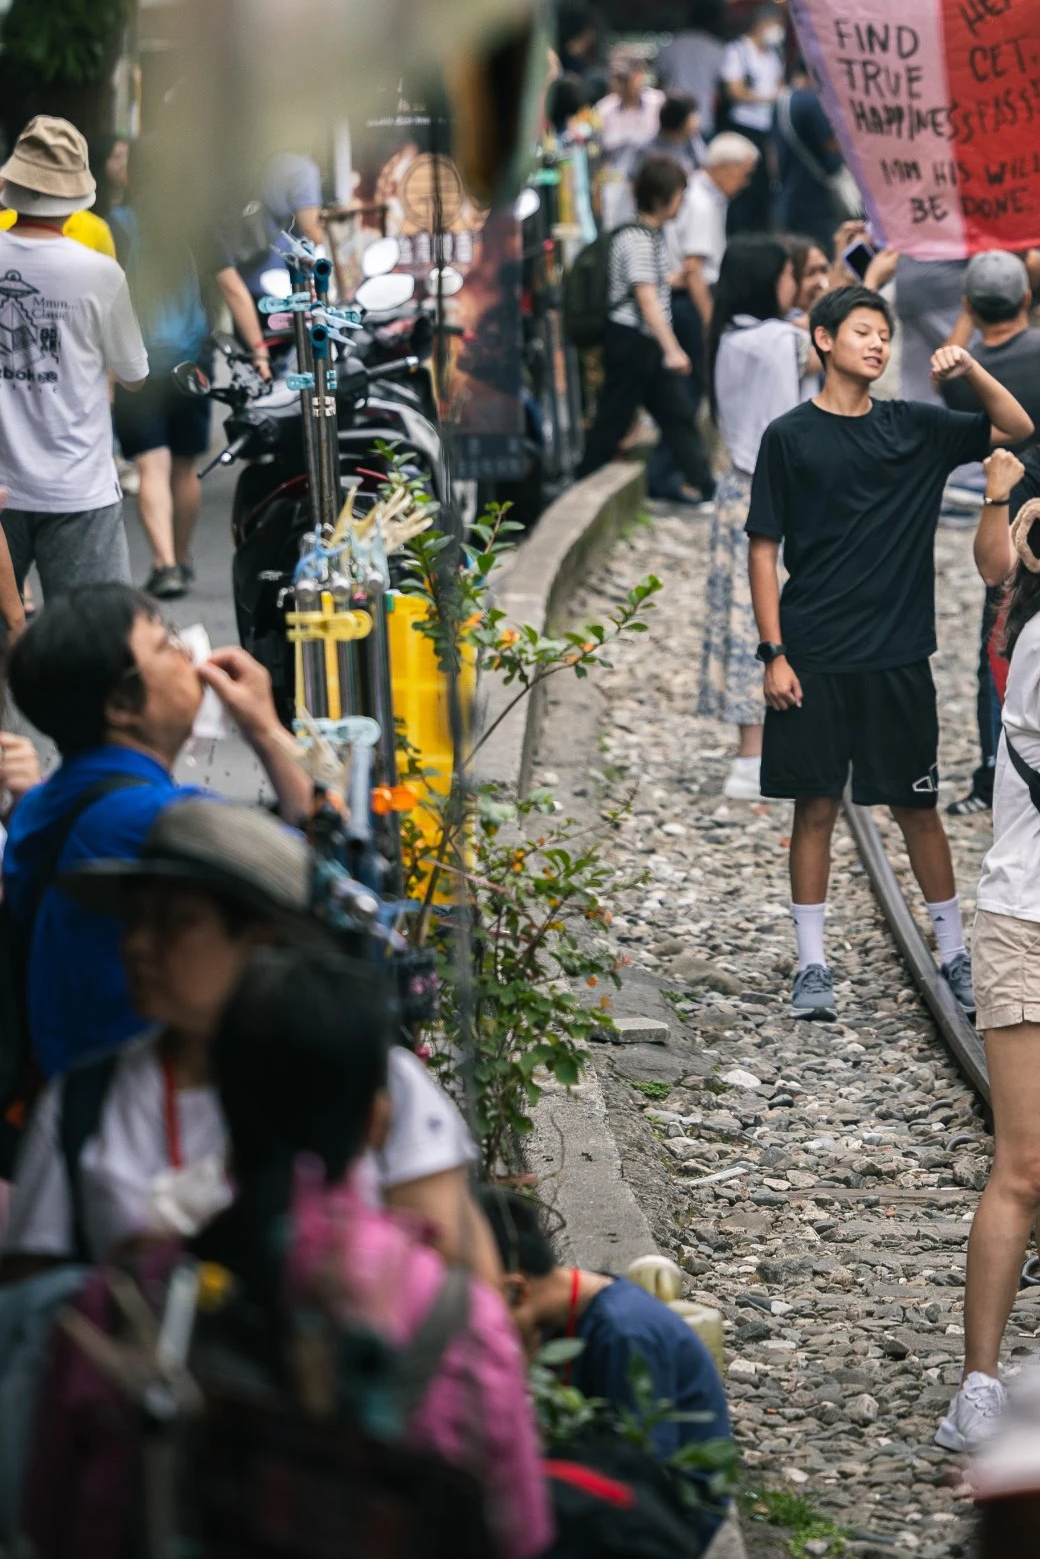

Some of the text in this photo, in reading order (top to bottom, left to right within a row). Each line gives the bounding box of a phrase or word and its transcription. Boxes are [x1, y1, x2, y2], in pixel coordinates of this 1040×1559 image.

[833, 18, 919, 59] FIND
[837, 57, 923, 100] TRUE
[850, 97, 974, 145] HAPPINESS
[911, 194, 948, 224] BE
